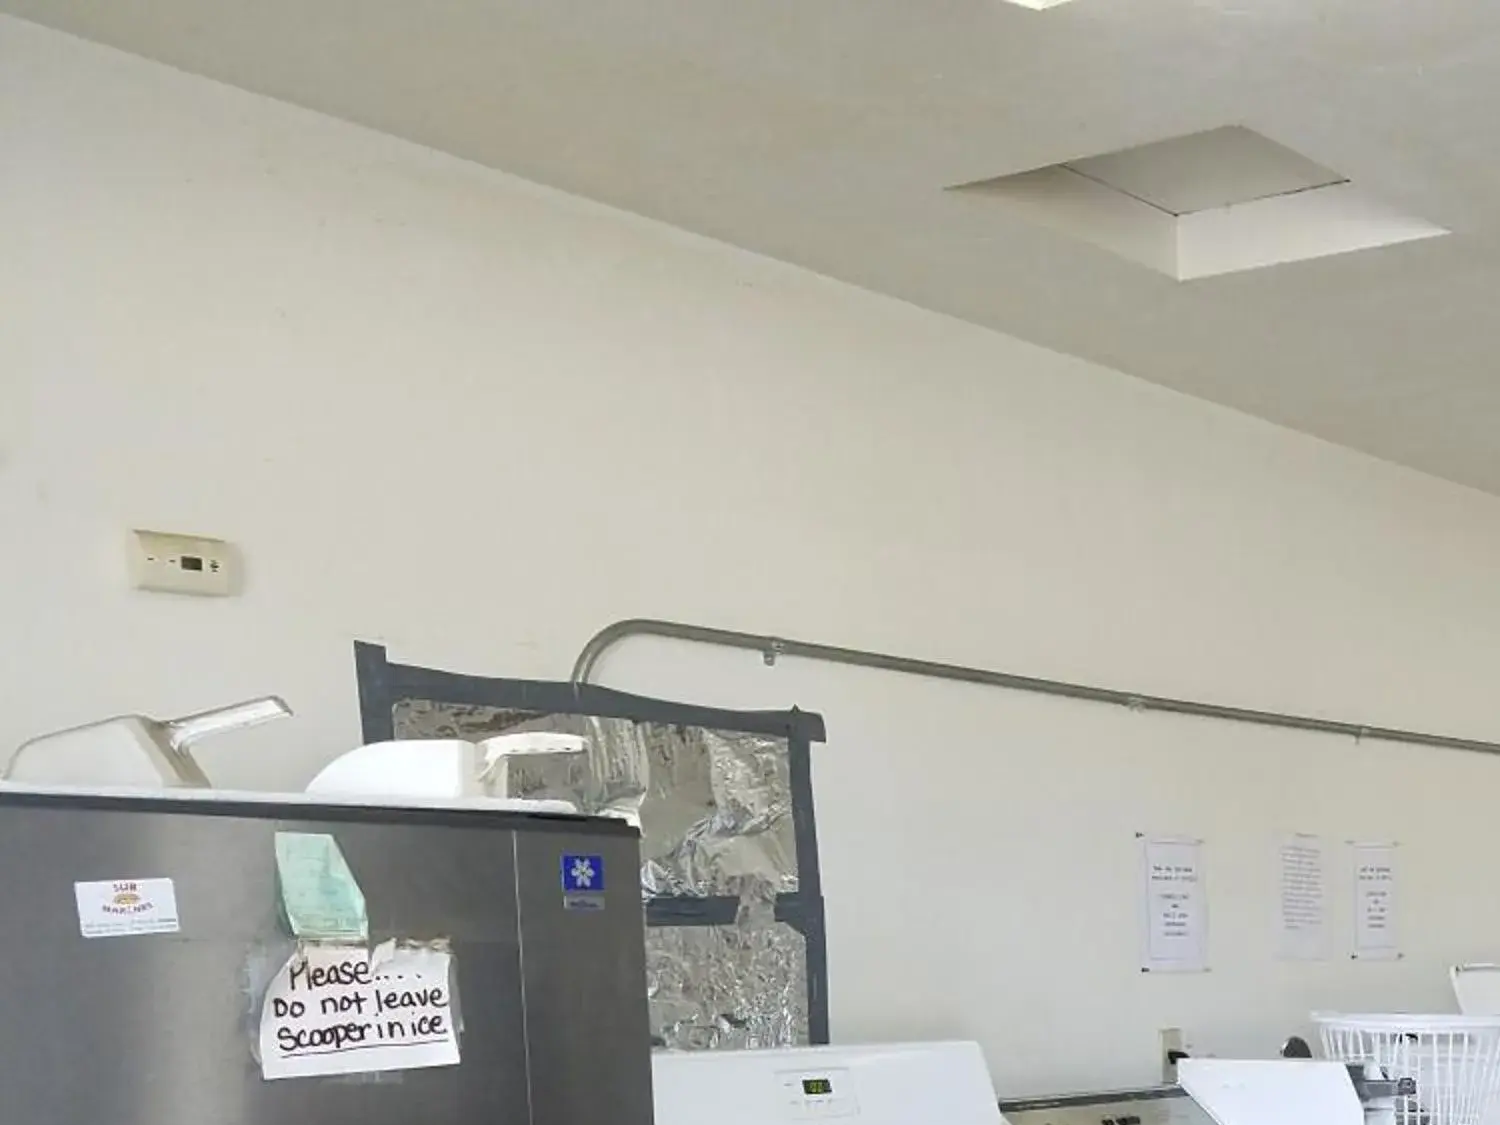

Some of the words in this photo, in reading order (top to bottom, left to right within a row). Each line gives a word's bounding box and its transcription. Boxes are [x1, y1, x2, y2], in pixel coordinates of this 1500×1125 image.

[273, 997, 306, 1018] Do
[320, 991, 367, 1015] not
[375, 987, 448, 1013] leave
[374, 1012, 405, 1039] in
[411, 1011, 447, 1037] ice
